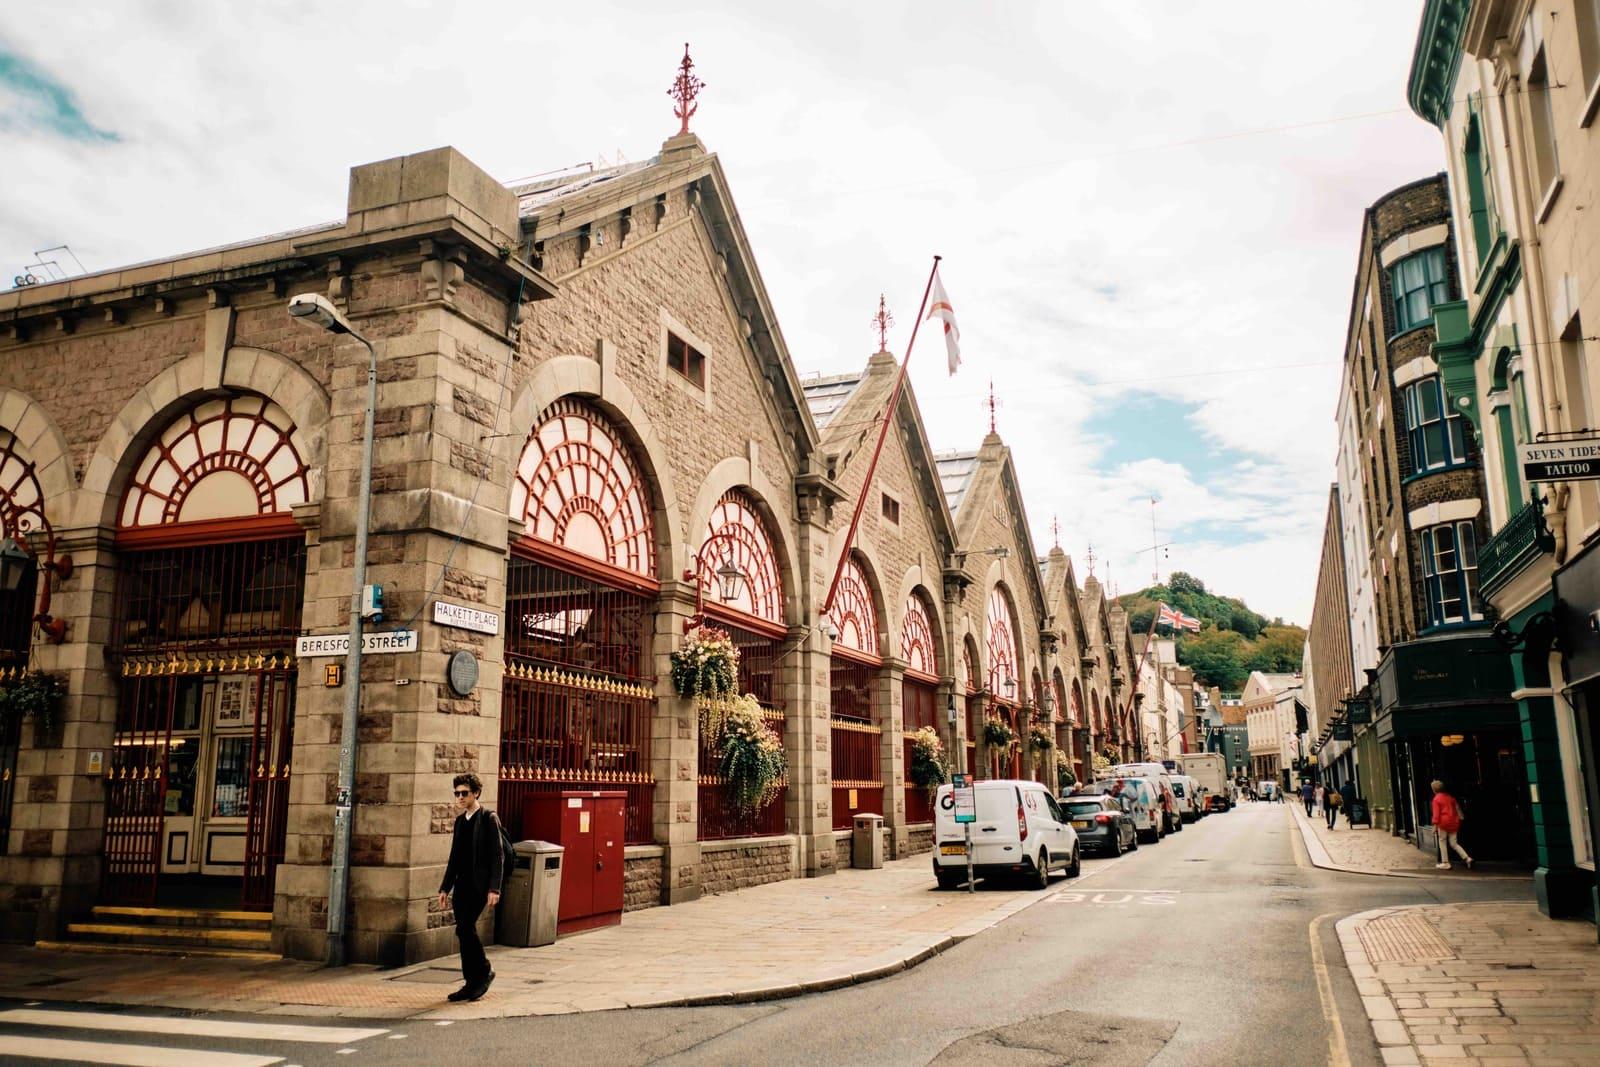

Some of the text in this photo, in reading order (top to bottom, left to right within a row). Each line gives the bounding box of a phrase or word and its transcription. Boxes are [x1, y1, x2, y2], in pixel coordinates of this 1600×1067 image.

[1527, 448, 1565, 460] SEVEN
[1544, 463, 1590, 476] TATTOO
[437, 603, 497, 627] HALKETT PLACE
[301, 637, 410, 652] BERESFOD STREET
[1044, 894, 1178, 904] BUS
